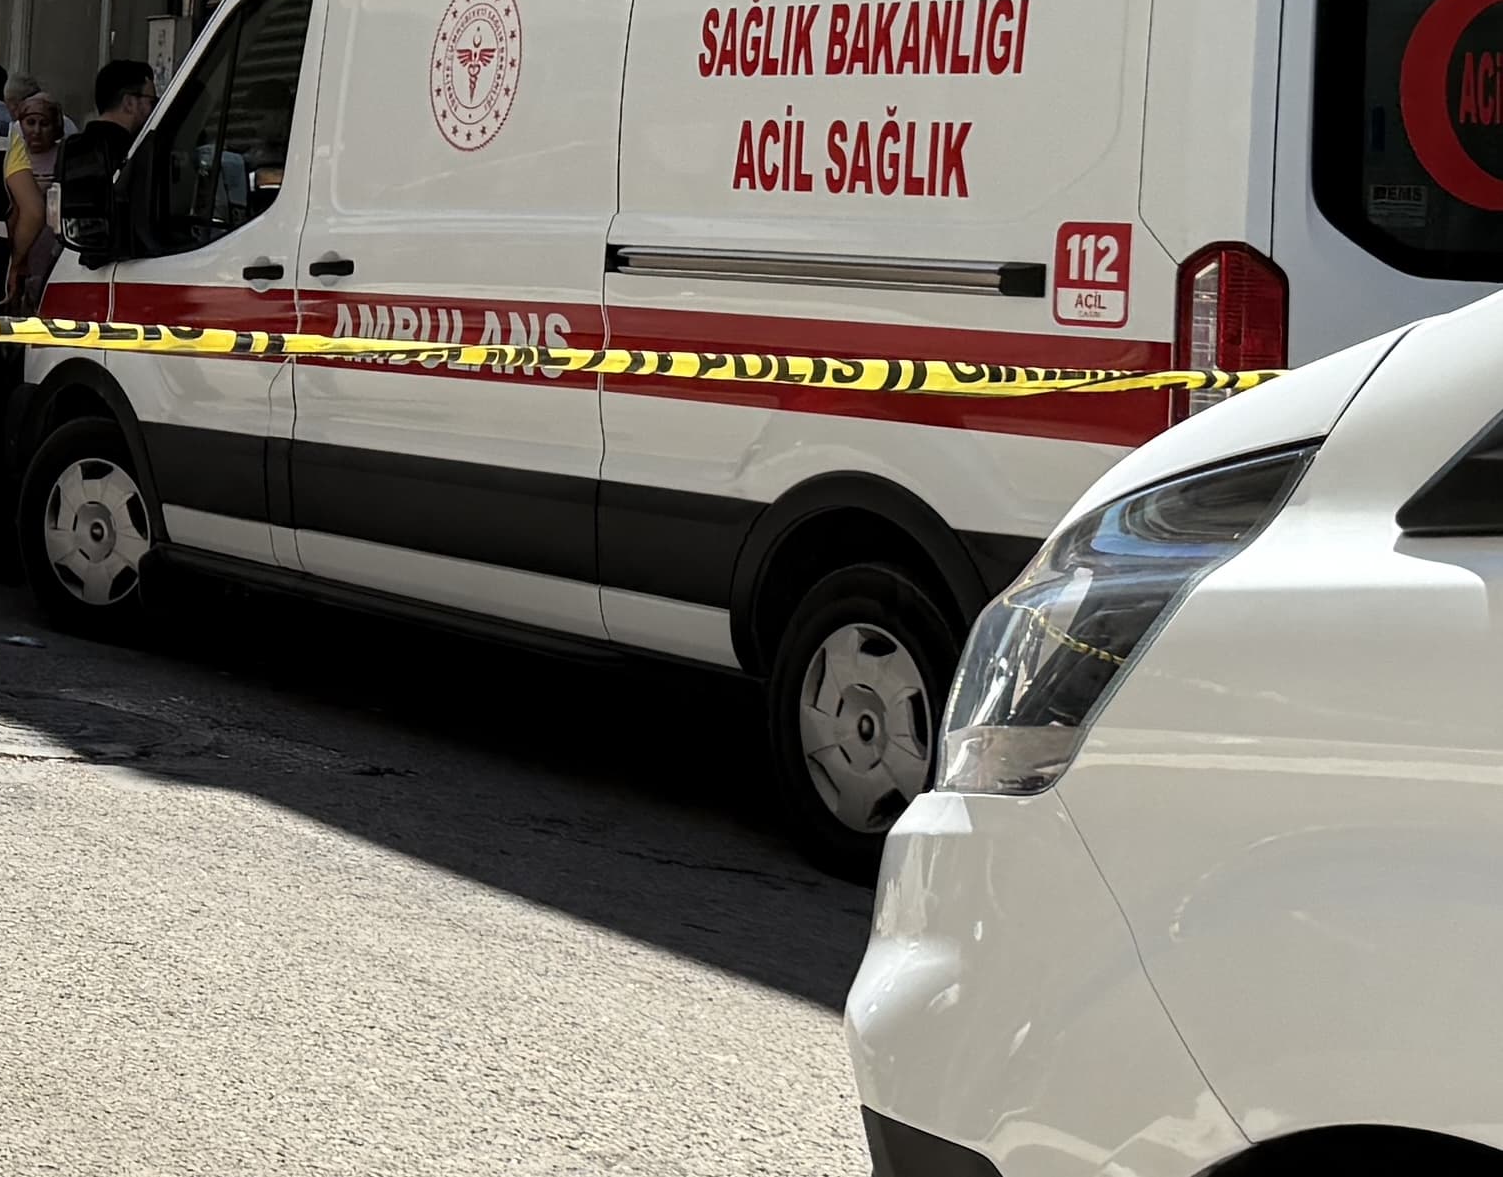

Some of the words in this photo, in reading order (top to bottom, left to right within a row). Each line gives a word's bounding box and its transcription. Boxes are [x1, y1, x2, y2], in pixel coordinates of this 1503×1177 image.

[733, 105, 814, 194] ACİL
[825, 107, 973, 198] SAĞLIK
[1066, 233, 1119, 283] 112
